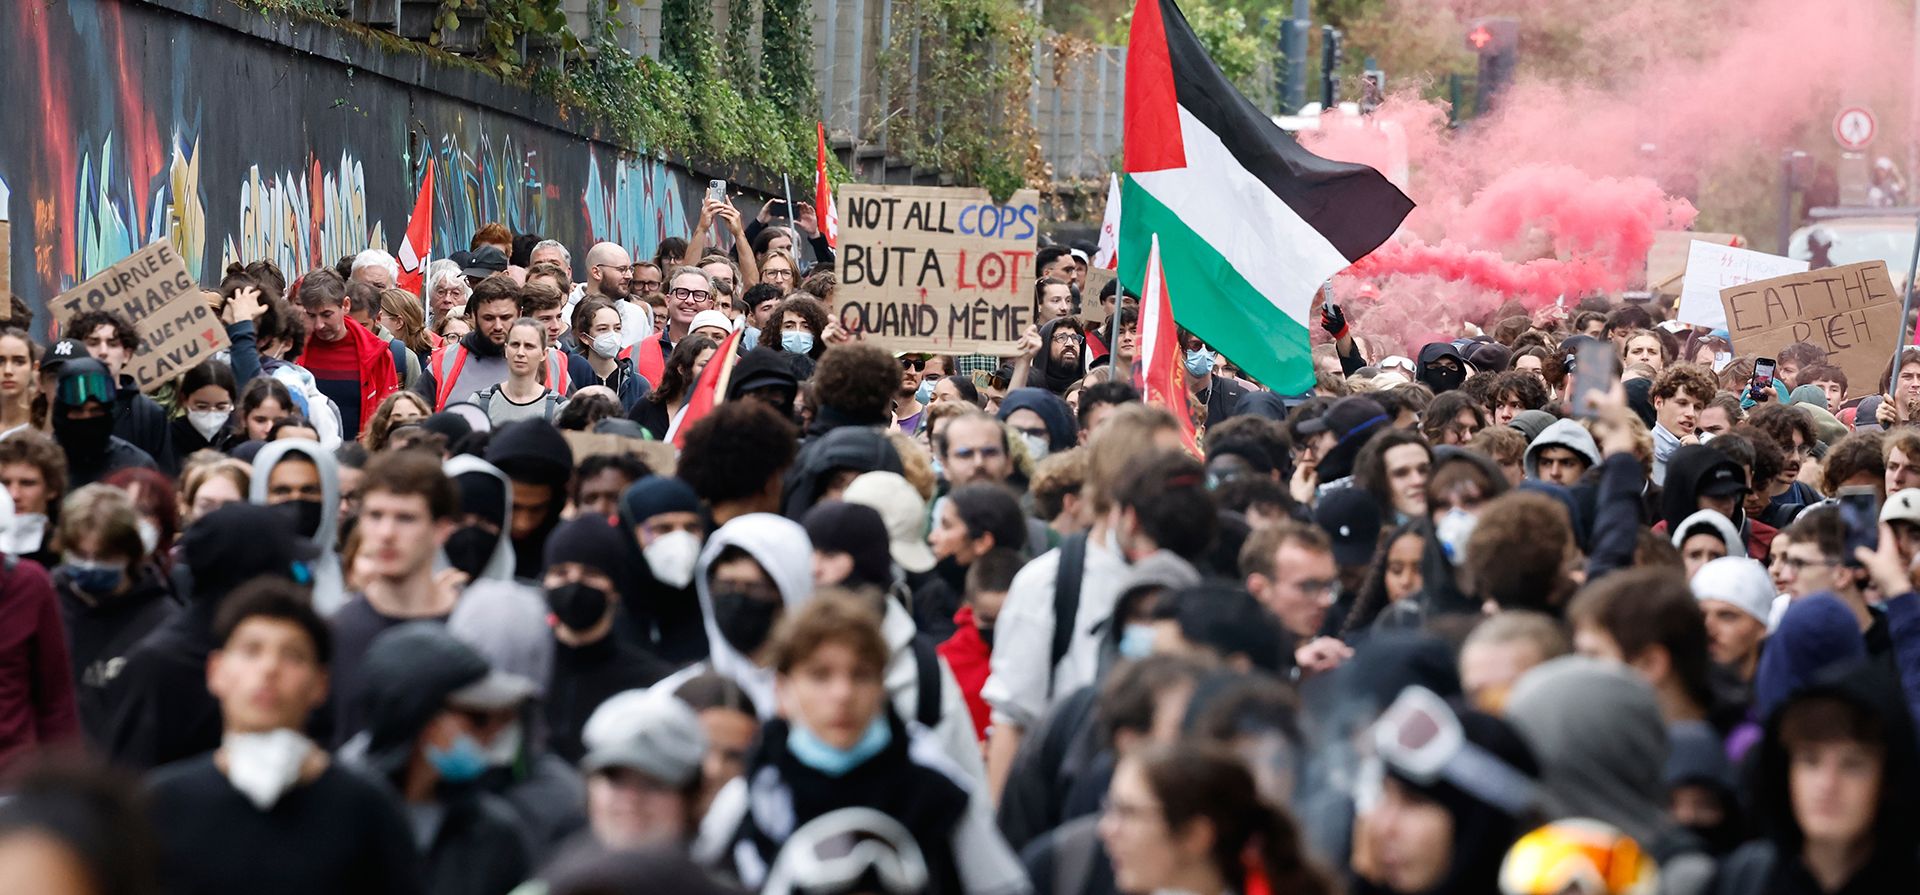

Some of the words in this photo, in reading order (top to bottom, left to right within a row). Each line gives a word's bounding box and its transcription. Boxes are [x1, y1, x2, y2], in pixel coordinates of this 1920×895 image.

[848, 197, 902, 231] NOT
[903, 201, 954, 234] ALL
[958, 204, 1038, 240] COPS
[64, 246, 173, 313] TOURNEE
[842, 244, 916, 287] BUT
[916, 248, 945, 287] A
[956, 249, 1035, 295] LOT
[113, 270, 190, 325] HARG
[840, 301, 939, 341] QUAND
[949, 297, 1029, 342] MÊME
[1730, 282, 1811, 331] EAT
[1813, 265, 1887, 309] THE
